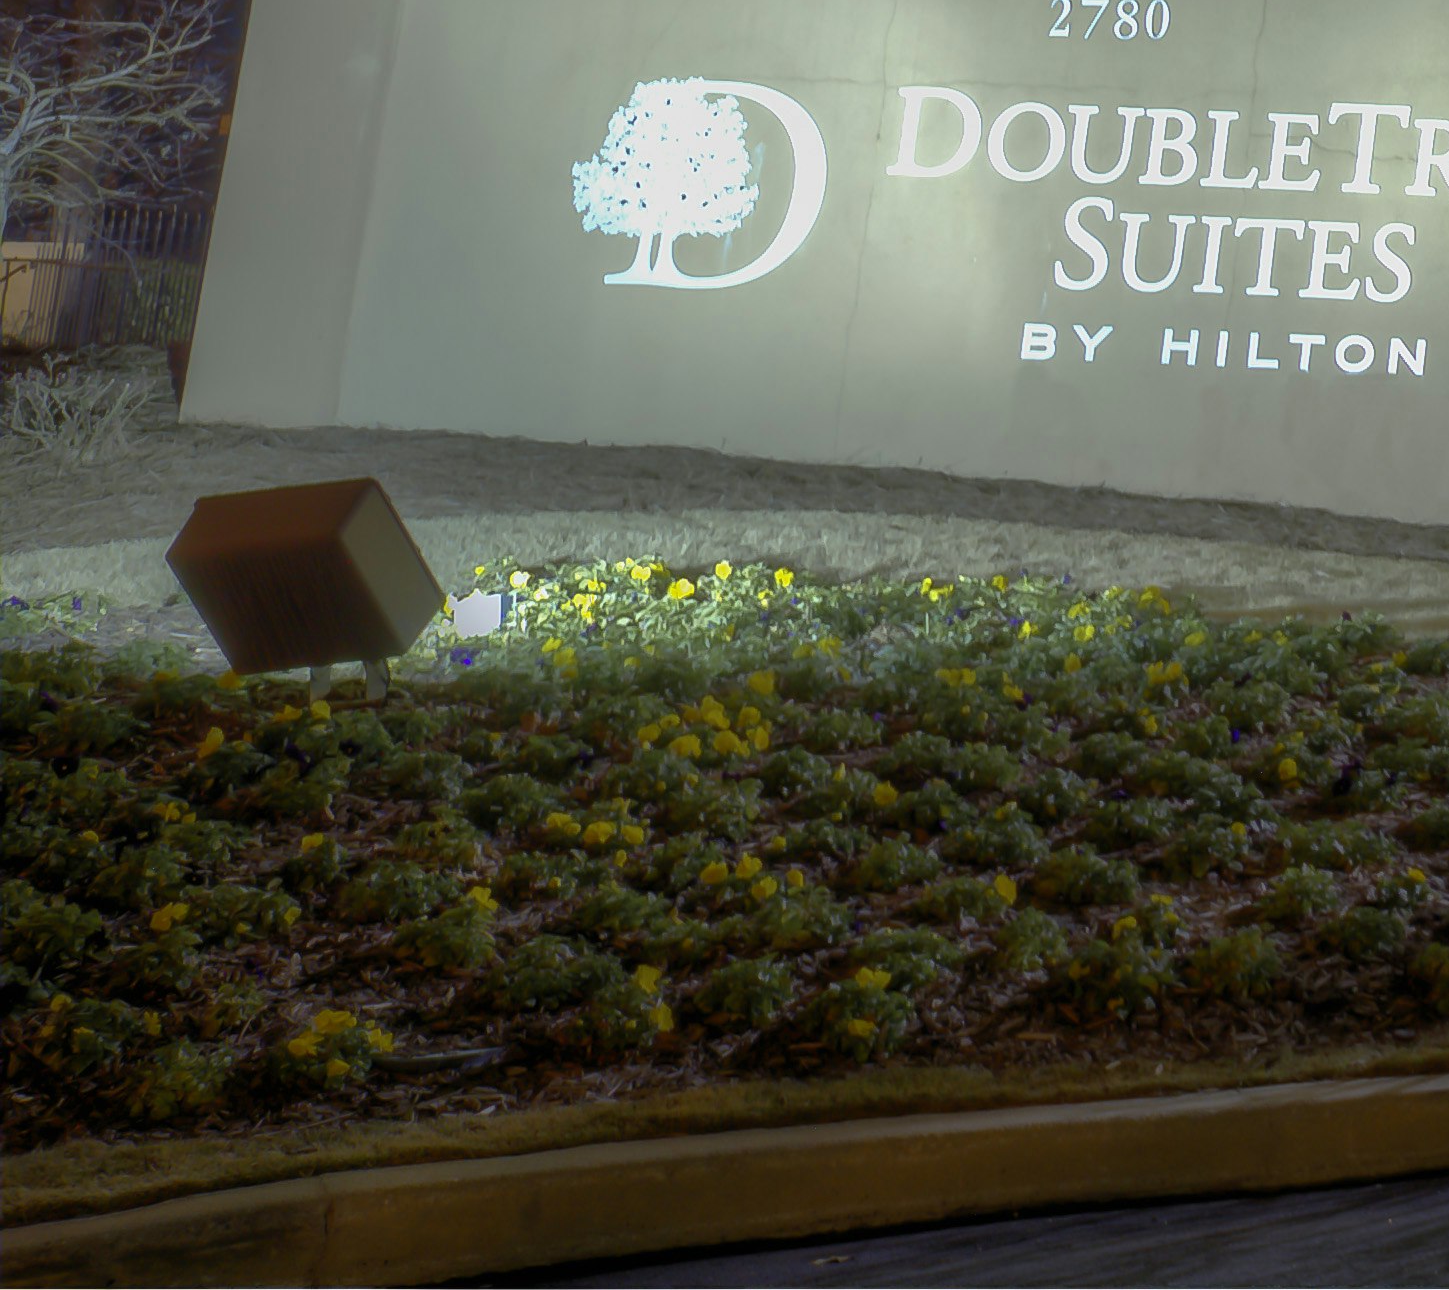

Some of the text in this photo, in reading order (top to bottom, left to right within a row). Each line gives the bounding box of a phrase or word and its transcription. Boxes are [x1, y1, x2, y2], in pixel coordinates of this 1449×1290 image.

[1053, 196, 1418, 305] SUITES
[1019, 322, 1428, 376] BY HILTON
